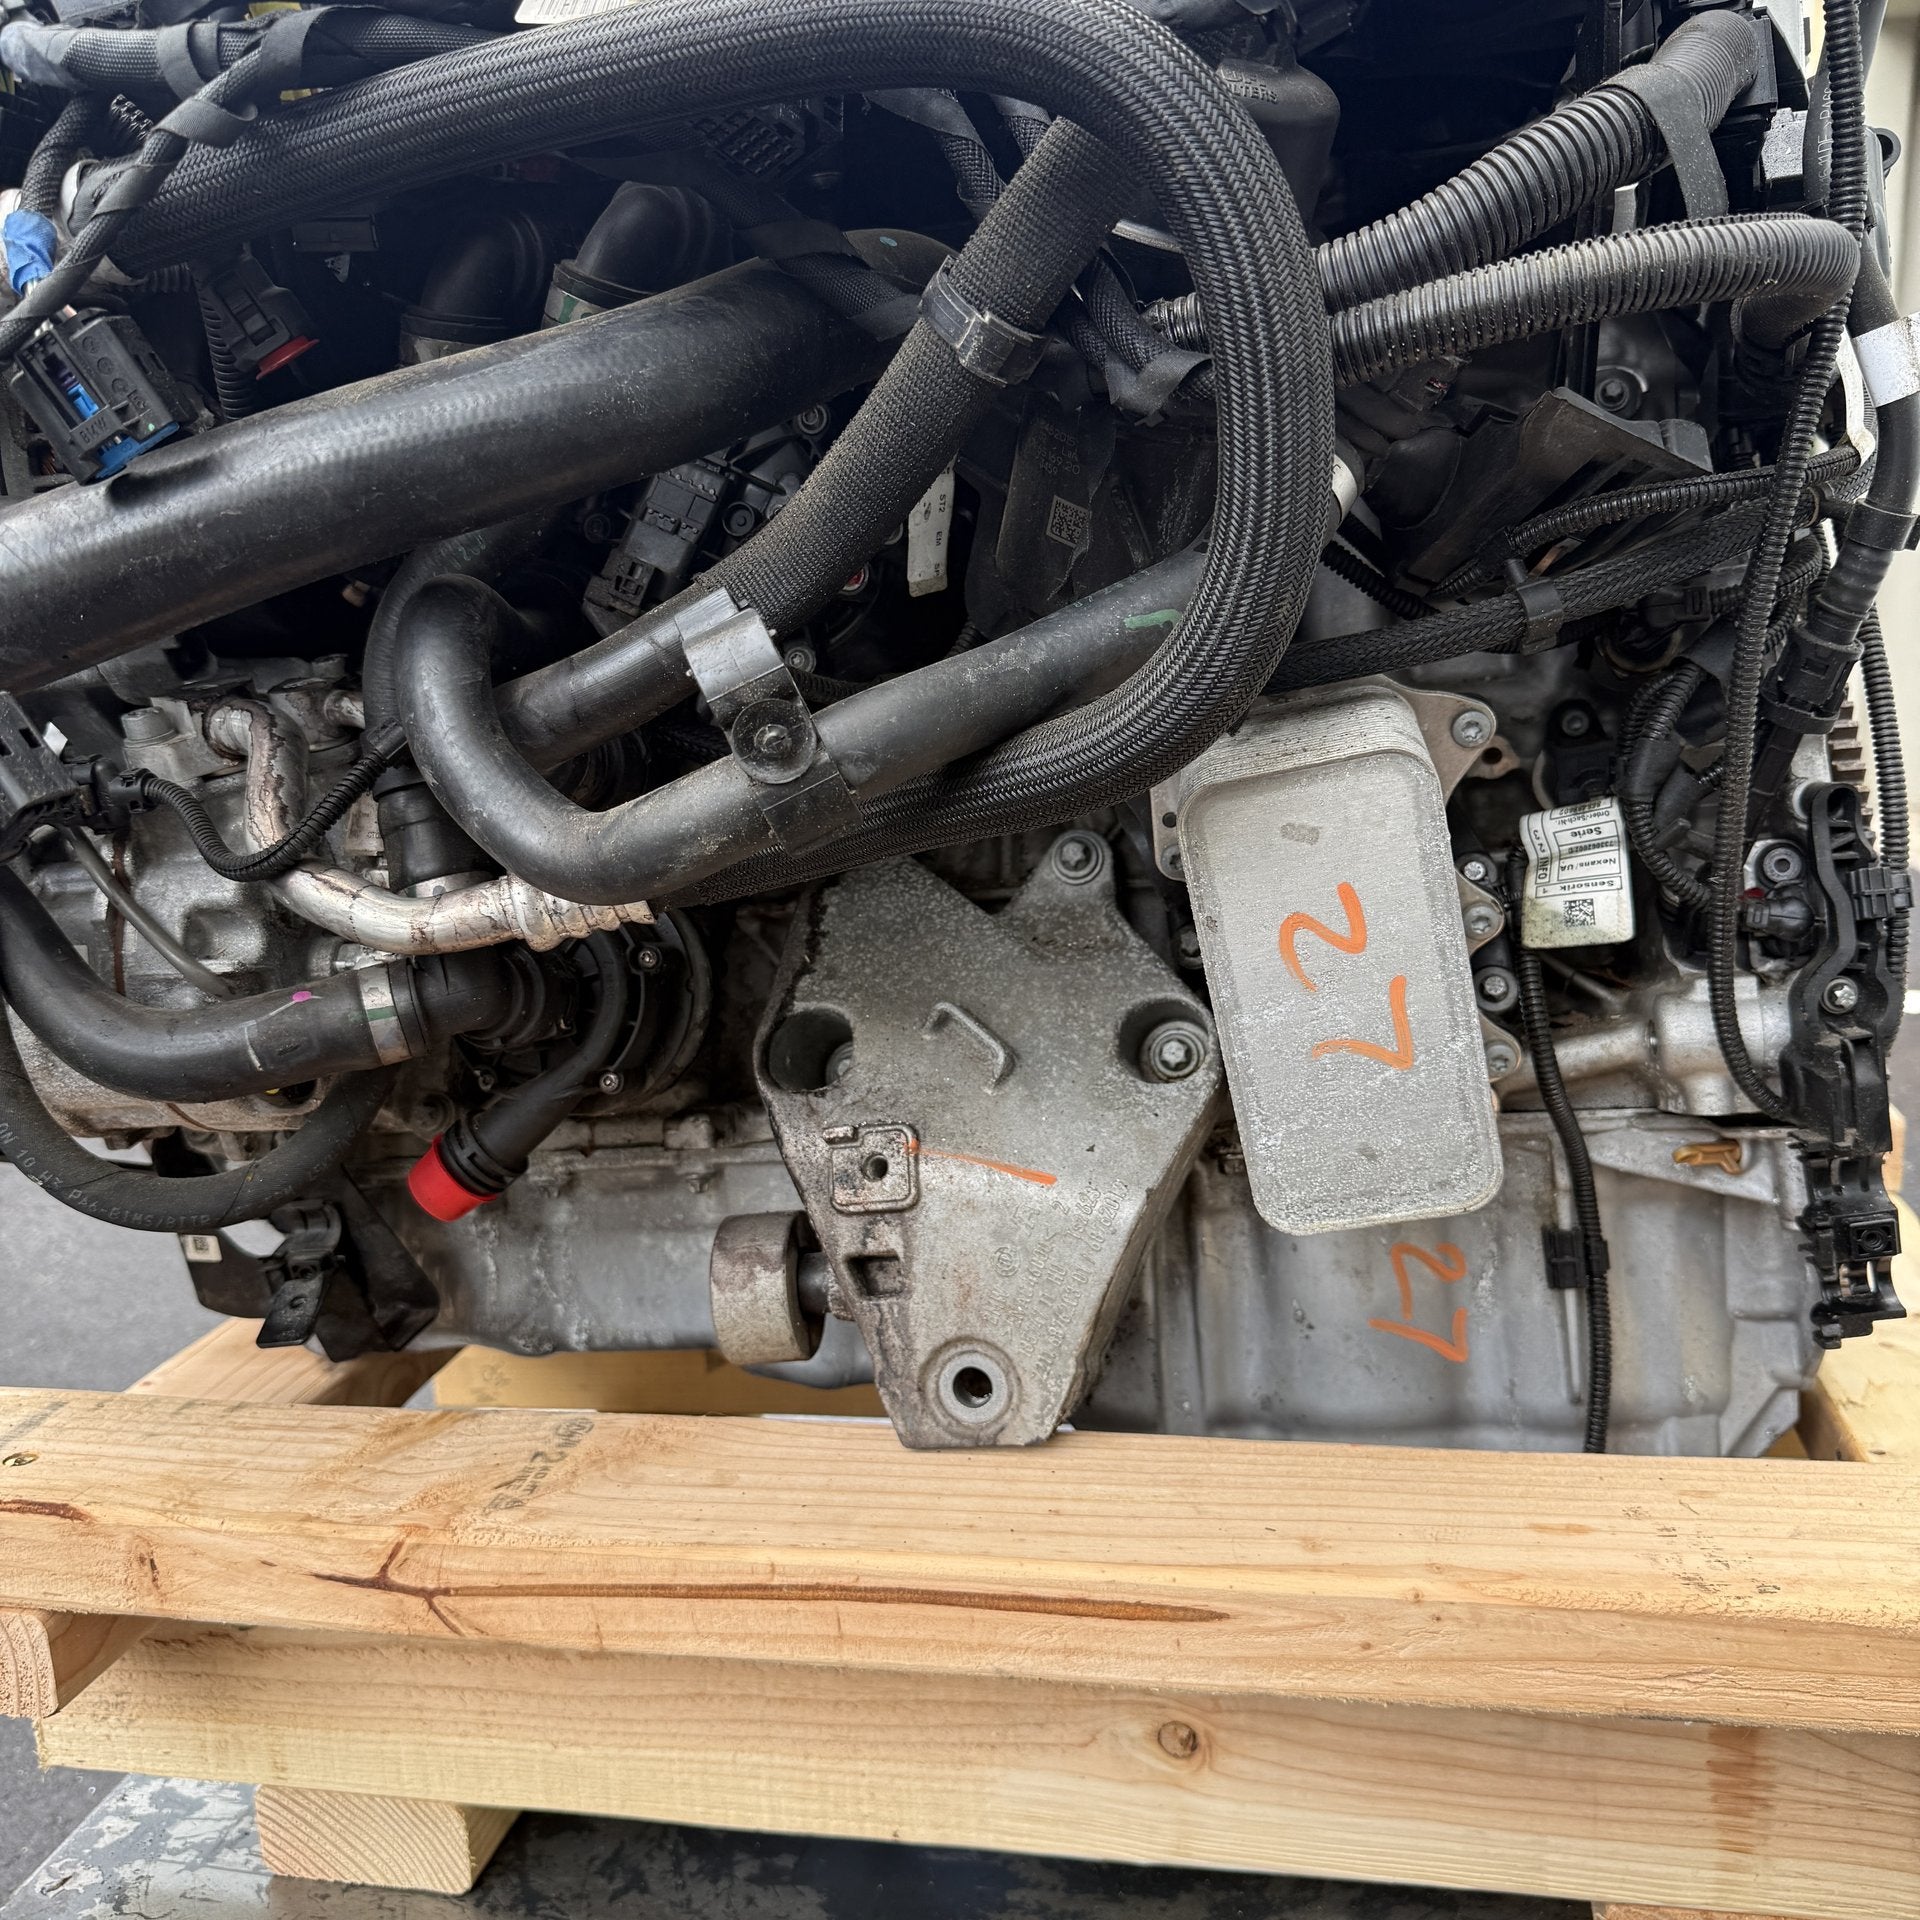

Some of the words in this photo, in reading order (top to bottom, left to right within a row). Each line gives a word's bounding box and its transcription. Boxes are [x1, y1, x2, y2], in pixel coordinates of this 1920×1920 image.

[80, 417, 107, 443] BMW
[1532, 829, 1541, 840] 3
[1571, 826, 1602, 838] Serie
[1537, 842, 1546, 853] 2
[1538, 856, 1550, 880] INFO
[1559, 879, 1614, 891] Sensorik
[1279, 881, 1414, 1071] 27
[1368, 1241, 1468, 1363] 27
